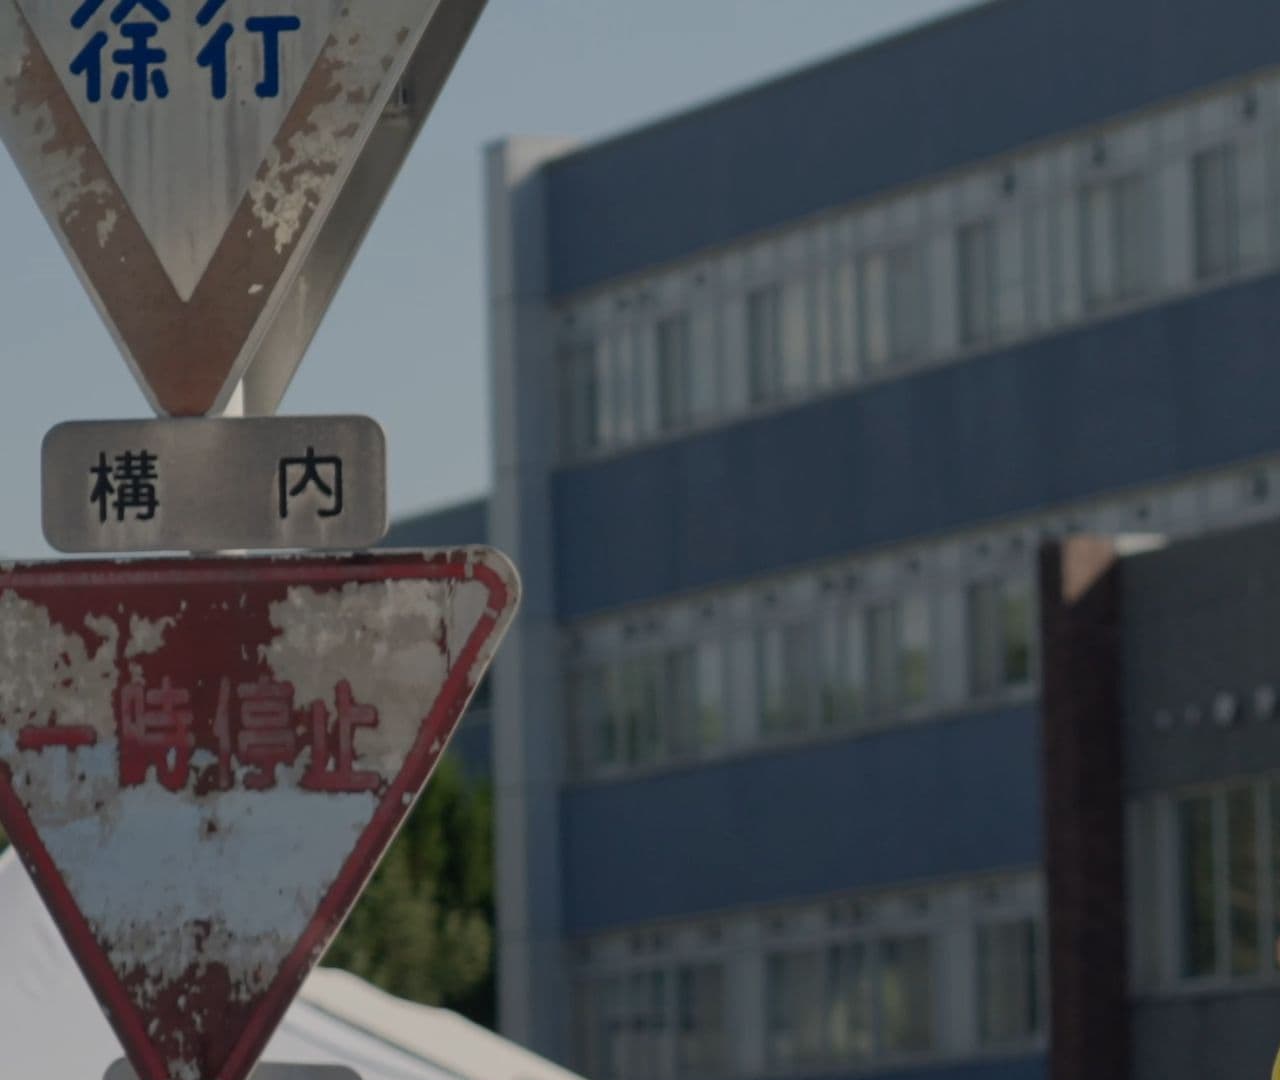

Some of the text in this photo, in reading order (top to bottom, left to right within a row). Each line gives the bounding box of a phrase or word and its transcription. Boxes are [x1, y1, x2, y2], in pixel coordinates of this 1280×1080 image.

[70, 0, 300, 102] 徐行
[17, 676, 382, 793] 一時停止
